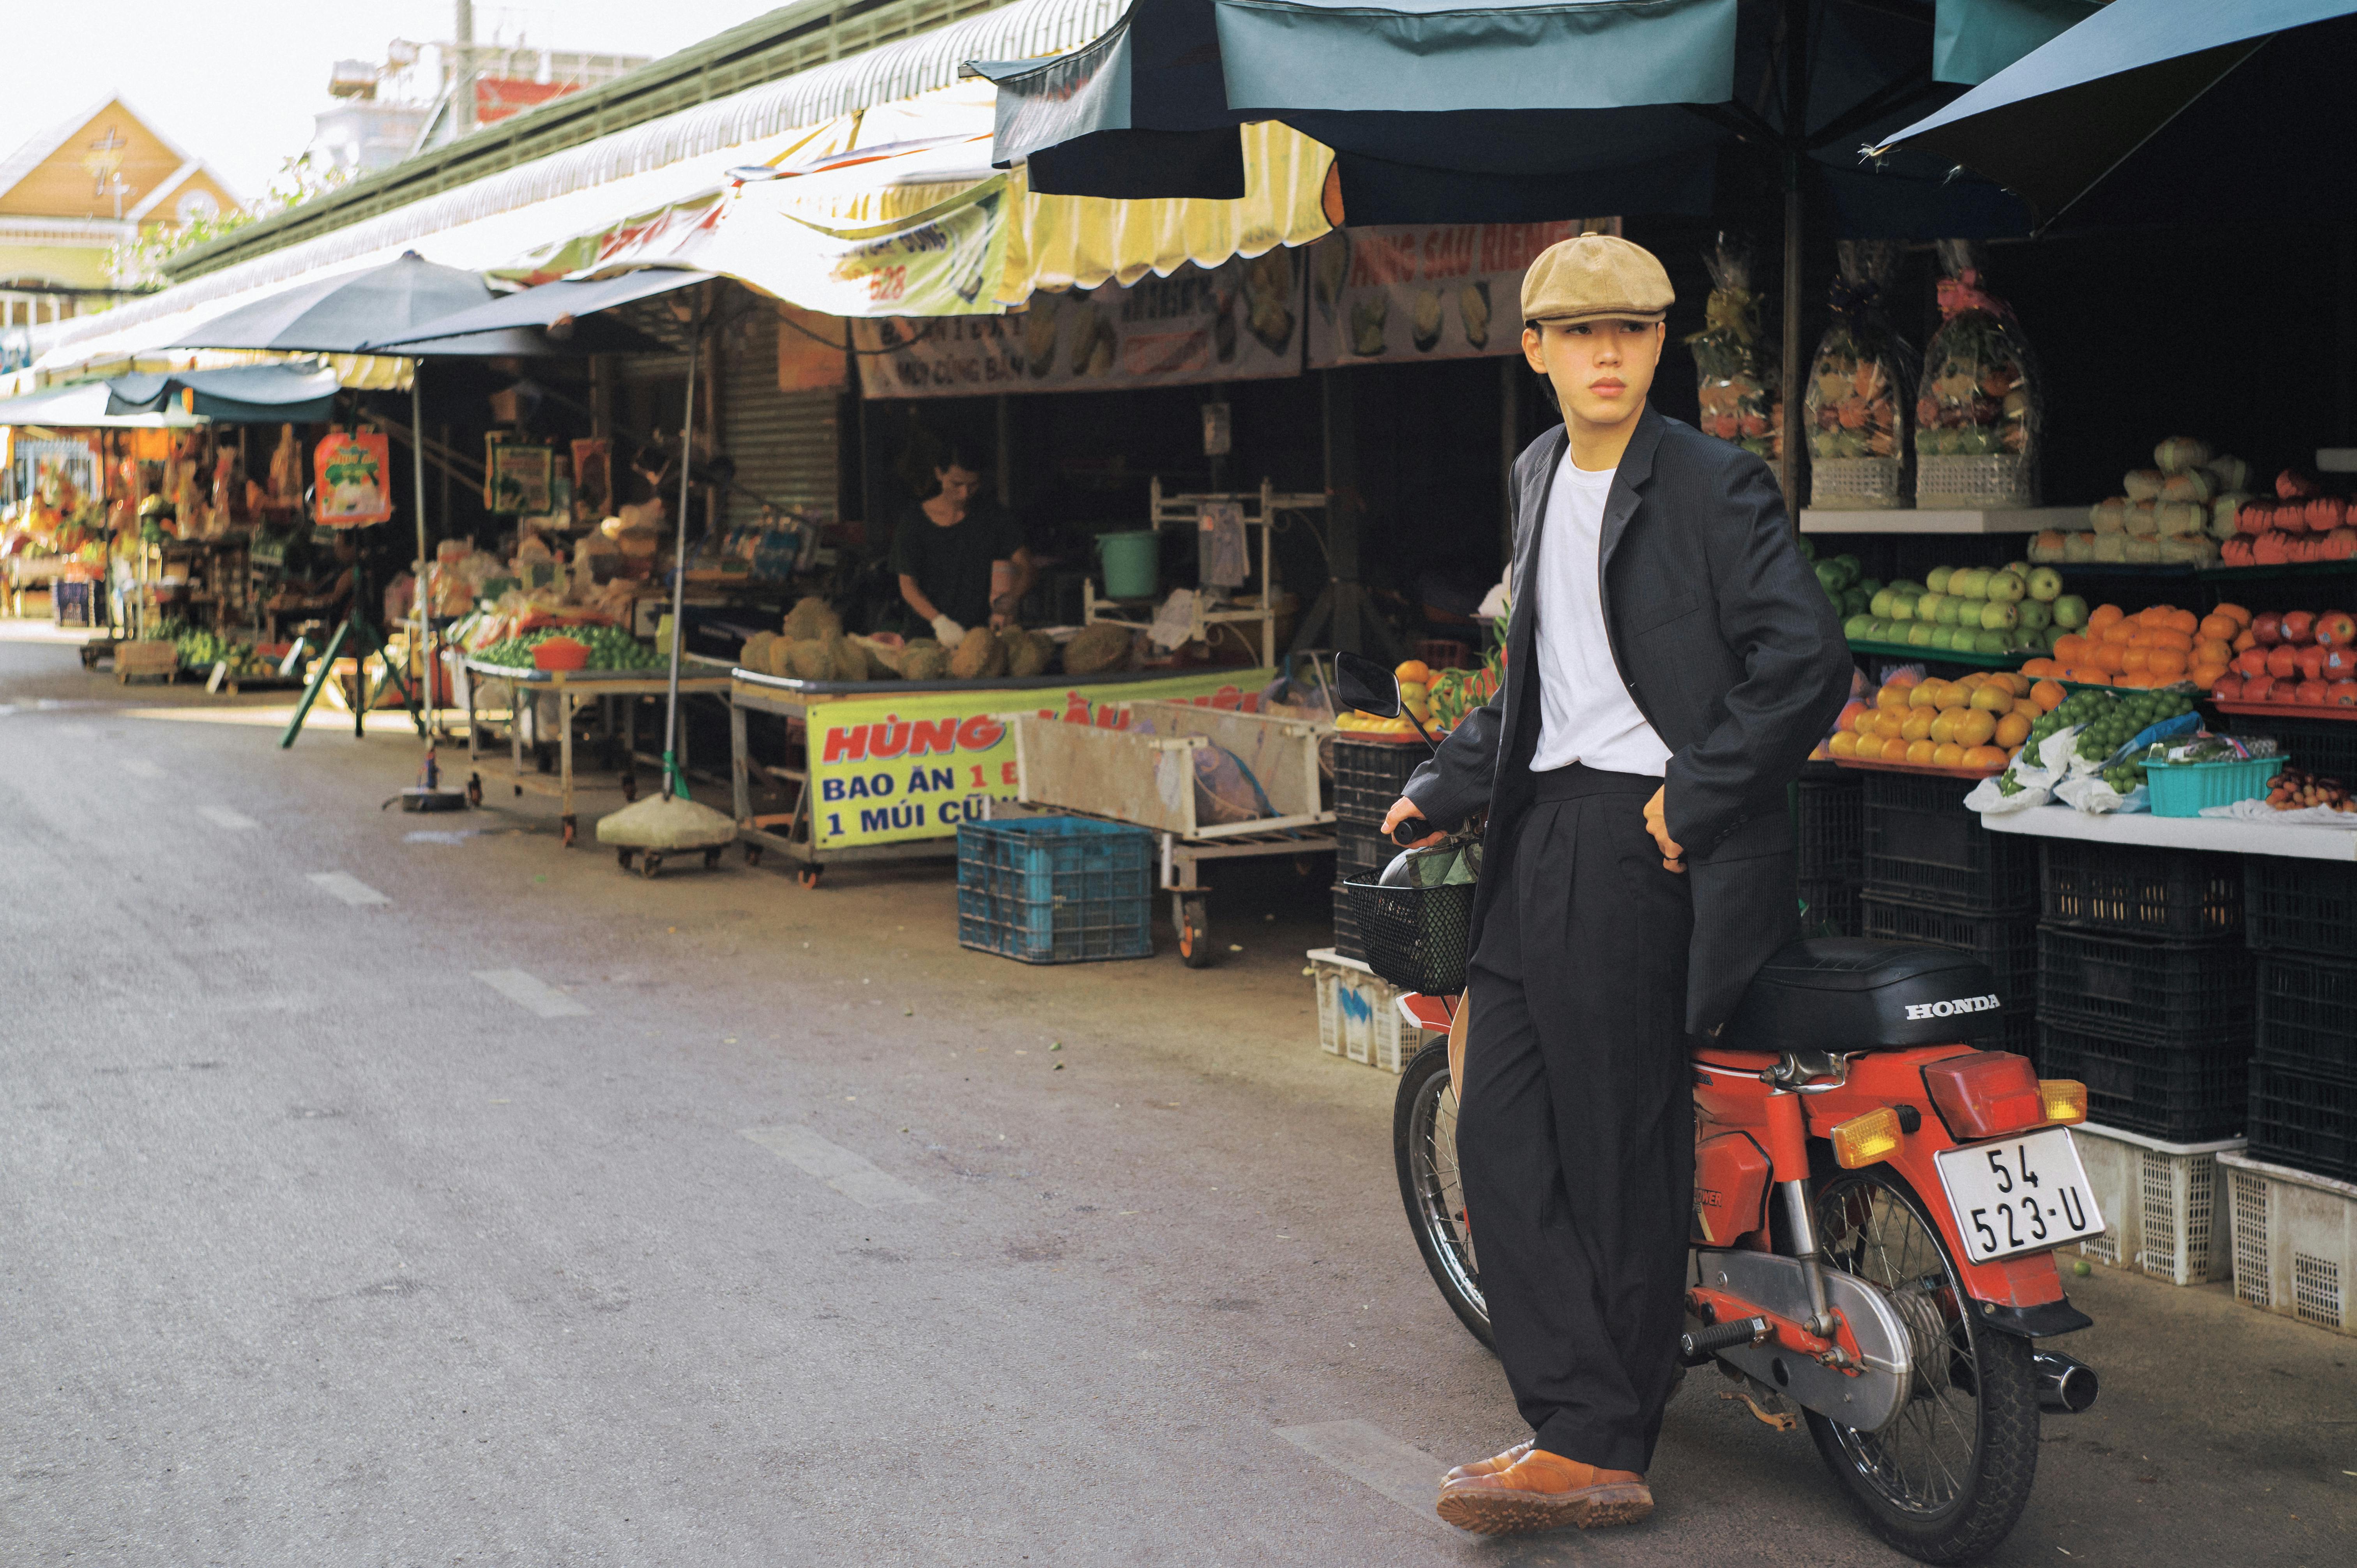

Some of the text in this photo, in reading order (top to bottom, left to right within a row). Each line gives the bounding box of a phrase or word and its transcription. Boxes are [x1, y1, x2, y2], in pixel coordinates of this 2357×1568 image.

[822, 714, 1006, 765] HÙNG
[822, 773, 894, 801] BAO
[908, 765, 954, 794] ĂN
[970, 765, 987, 788] 1
[827, 813, 844, 835] 1
[860, 800, 924, 832] MÚI
[1905, 994, 2001, 1020] HONDA
[1986, 1144, 2038, 1193] 54
[1694, 1188, 1722, 1208] OWER
